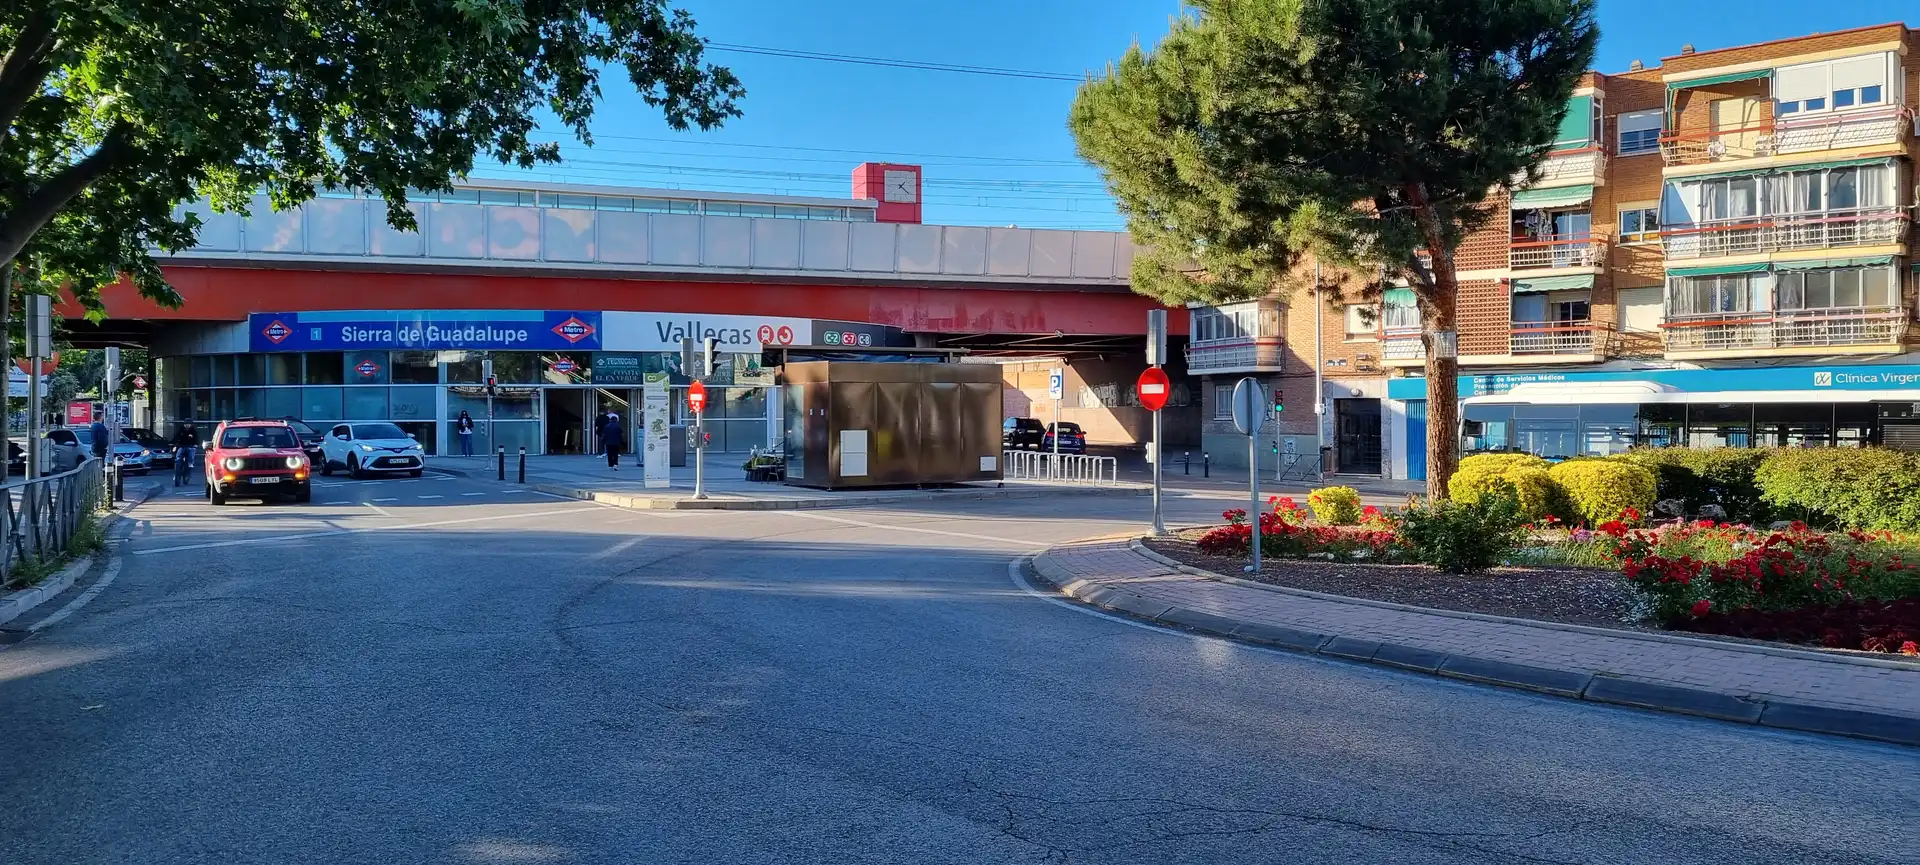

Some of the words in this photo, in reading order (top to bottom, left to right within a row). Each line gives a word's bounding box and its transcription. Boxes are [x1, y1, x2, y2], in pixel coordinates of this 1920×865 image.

[341, 325, 392, 346] Sierra
[398, 325, 420, 346] de
[426, 325, 528, 346] Guadalupe
[563, 326, 584, 334] Metro
[656, 320, 752, 345] Vallecas
[826, 333, 838, 343] C-2
[843, 334, 855, 344] C-7
[859, 335, 870, 345] C-8
[1506, 375, 1536, 383] Servicios
[1538, 374, 1565, 382] Médicos
[1836, 373, 1878, 383] Clínica
